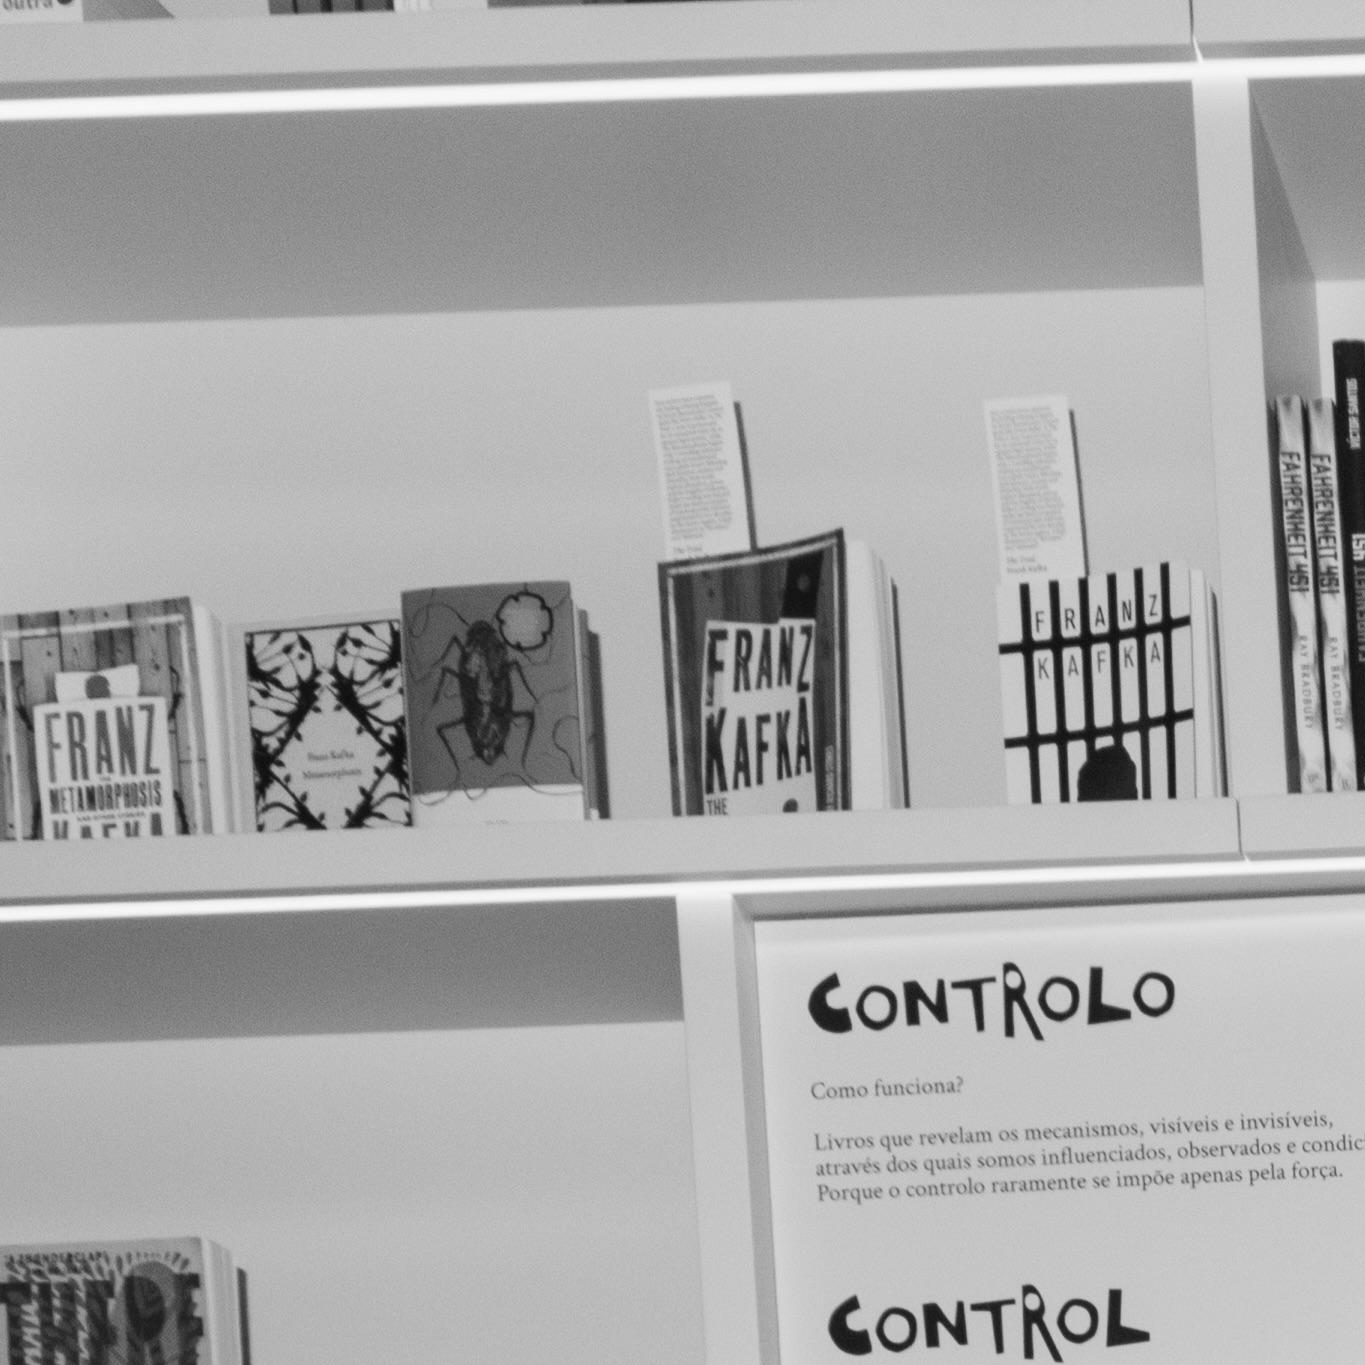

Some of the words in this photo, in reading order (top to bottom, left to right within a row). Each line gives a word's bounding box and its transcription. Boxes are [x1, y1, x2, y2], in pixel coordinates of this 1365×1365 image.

[1282, 451, 1306, 558] FAHRENHEIT
[1290, 563, 1308, 592] 451
[1034, 594, 1159, 634] FRANZ
[705, 624, 814, 707] FRANZ
[1037, 641, 1161, 680] KAFKA
[44, 704, 158, 782] FRANZ
[705, 700, 814, 794] KAFKA
[49, 780, 161, 813] METAMORPHOSIS
[808, 962, 1176, 1042] CONTROLO
[810, 1081, 869, 1100] Como
[874, 1075, 964, 1097] funciona?
[814, 1133, 874, 1151] Livros
[879, 1134, 913, 1153] que
[919, 1126, 993, 1146] revelam
[998, 1129, 1019, 1142] os
[1024, 1121, 1144, 1141] mecanismos,
[1149, 1115, 1219, 1134] visíveis
[1224, 1119, 1234, 1131] e
[1240, 1110, 1333, 1130] invisíveis,
[816, 1157, 881, 1176] através
[886, 1154, 918, 1173] dos
[923, 1153, 972, 1176] quais
[977, 1154, 1036, 1168] somos
[1041, 1143, 1171, 1166] influenciados,
[1177, 1138, 1281, 1159] observados
[1286, 1142, 1296, 1154] e
[817, 1184, 883, 1205] Porque
[888, 1186, 900, 1198] o
[905, 1176, 985, 1197] controlo
[991, 1176, 1087, 1193] raramente
[1092, 1176, 1110, 1189] se
[1116, 1170, 1175, 1191] impõe
[1180, 1170, 1243, 1189] apenas
[1248, 1162, 1286, 1186] pela
[1292, 1161, 1343, 1180] força.
[828, 1284, 1151, 1363] CONTROL
